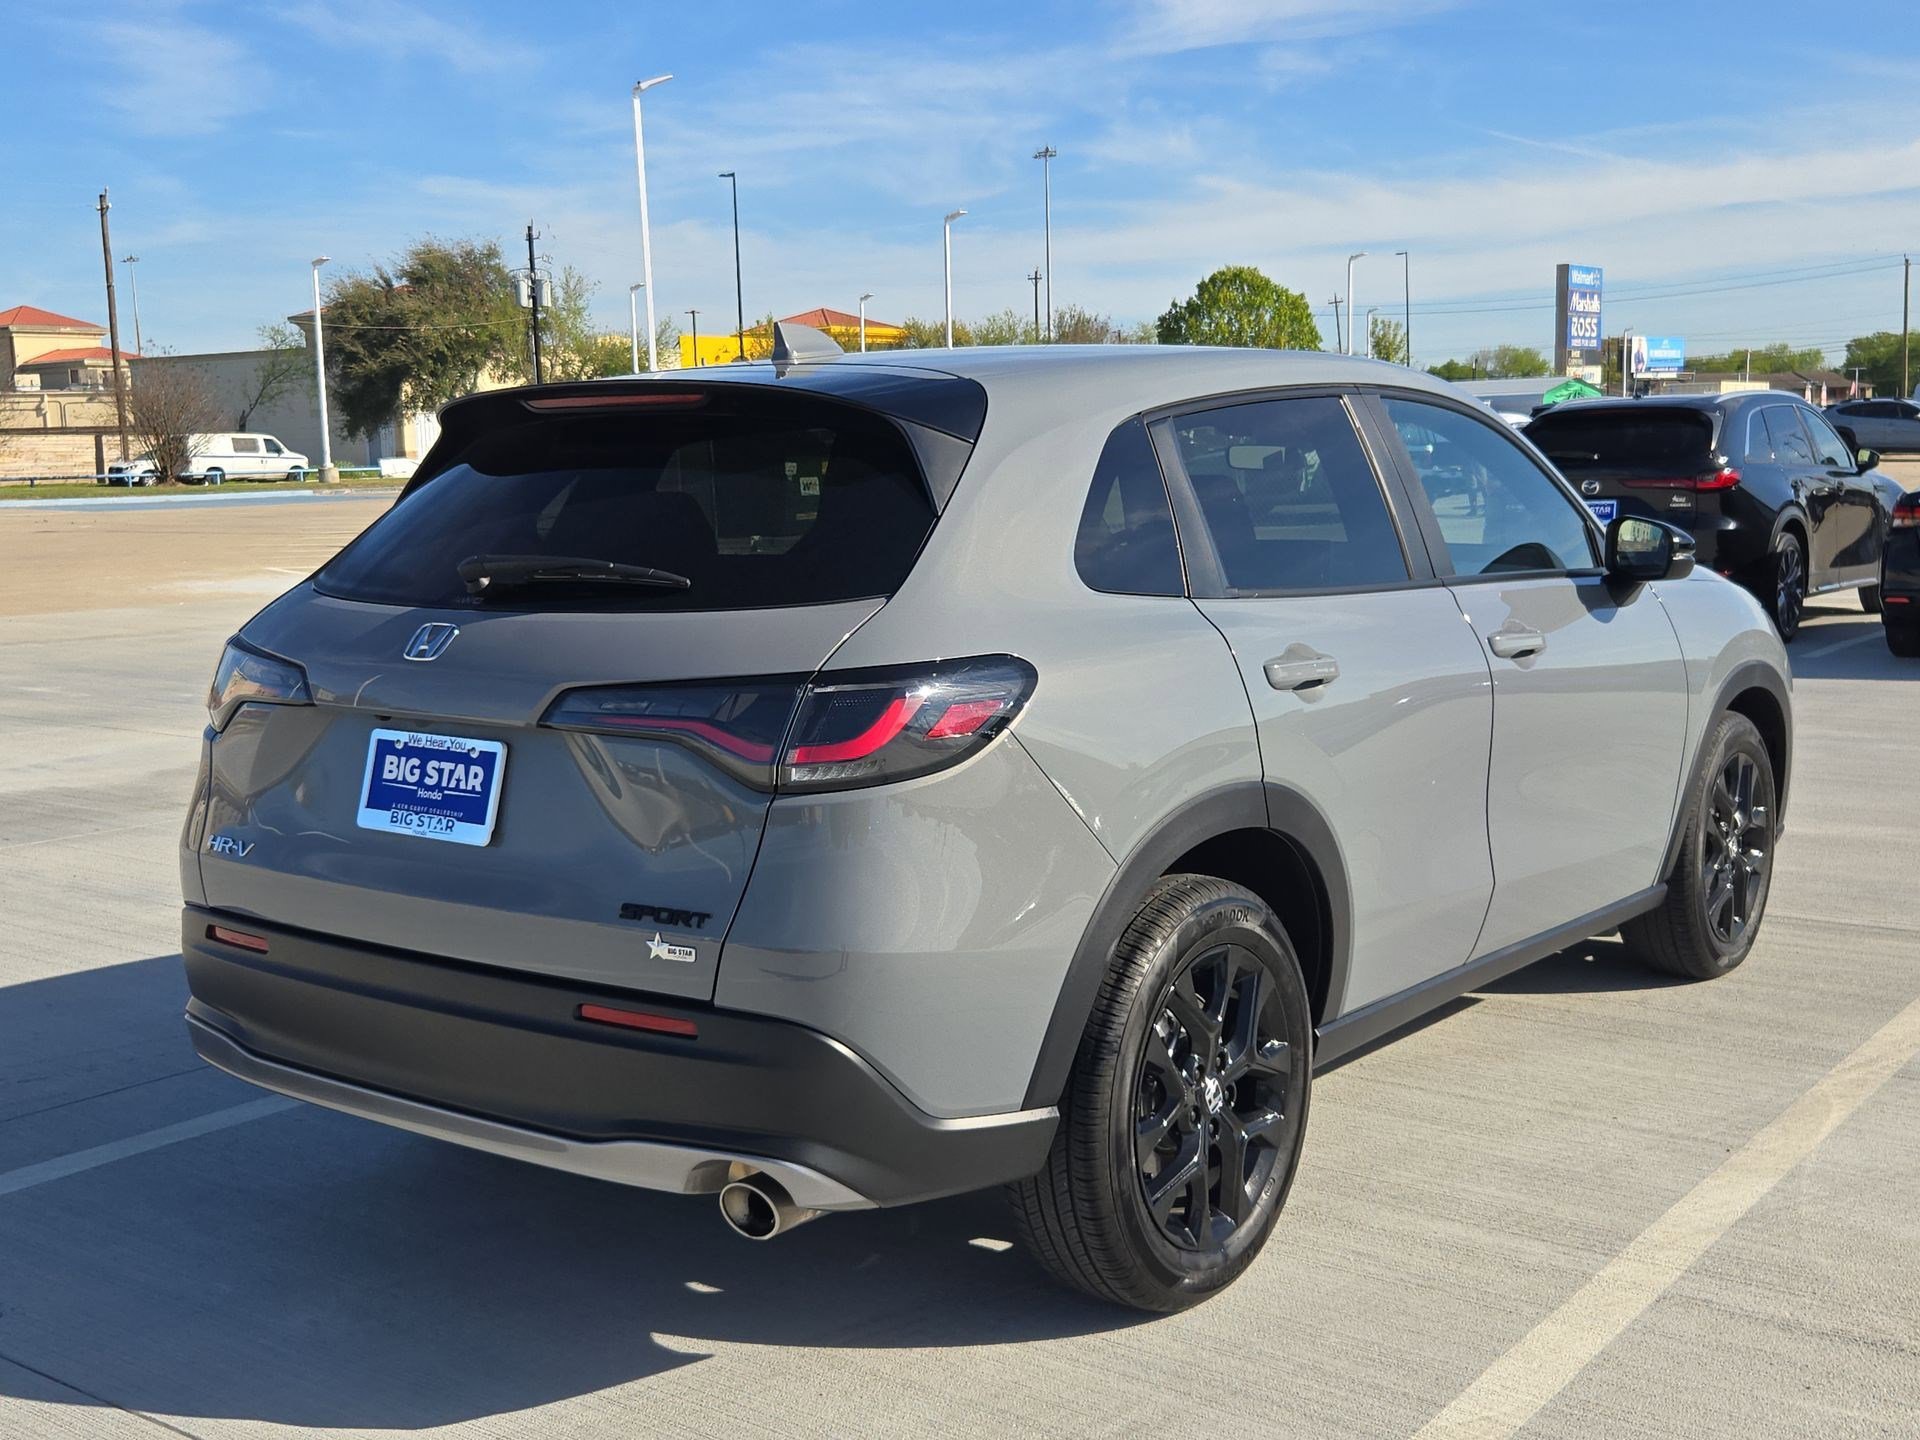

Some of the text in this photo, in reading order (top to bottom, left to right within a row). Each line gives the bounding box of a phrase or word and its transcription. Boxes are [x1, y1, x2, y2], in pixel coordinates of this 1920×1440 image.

[1569, 292, 1600, 313] Marshalls
[1571, 317, 1598, 338] ROSS
[408, 734, 467, 751] We Hear You
[382, 755, 485, 792] BIG STAR
[417, 788, 443, 801] Honda
[390, 810, 455, 833] BIG STAR
[207, 834, 255, 857] HR-V
[619, 902, 713, 929] SPORT
